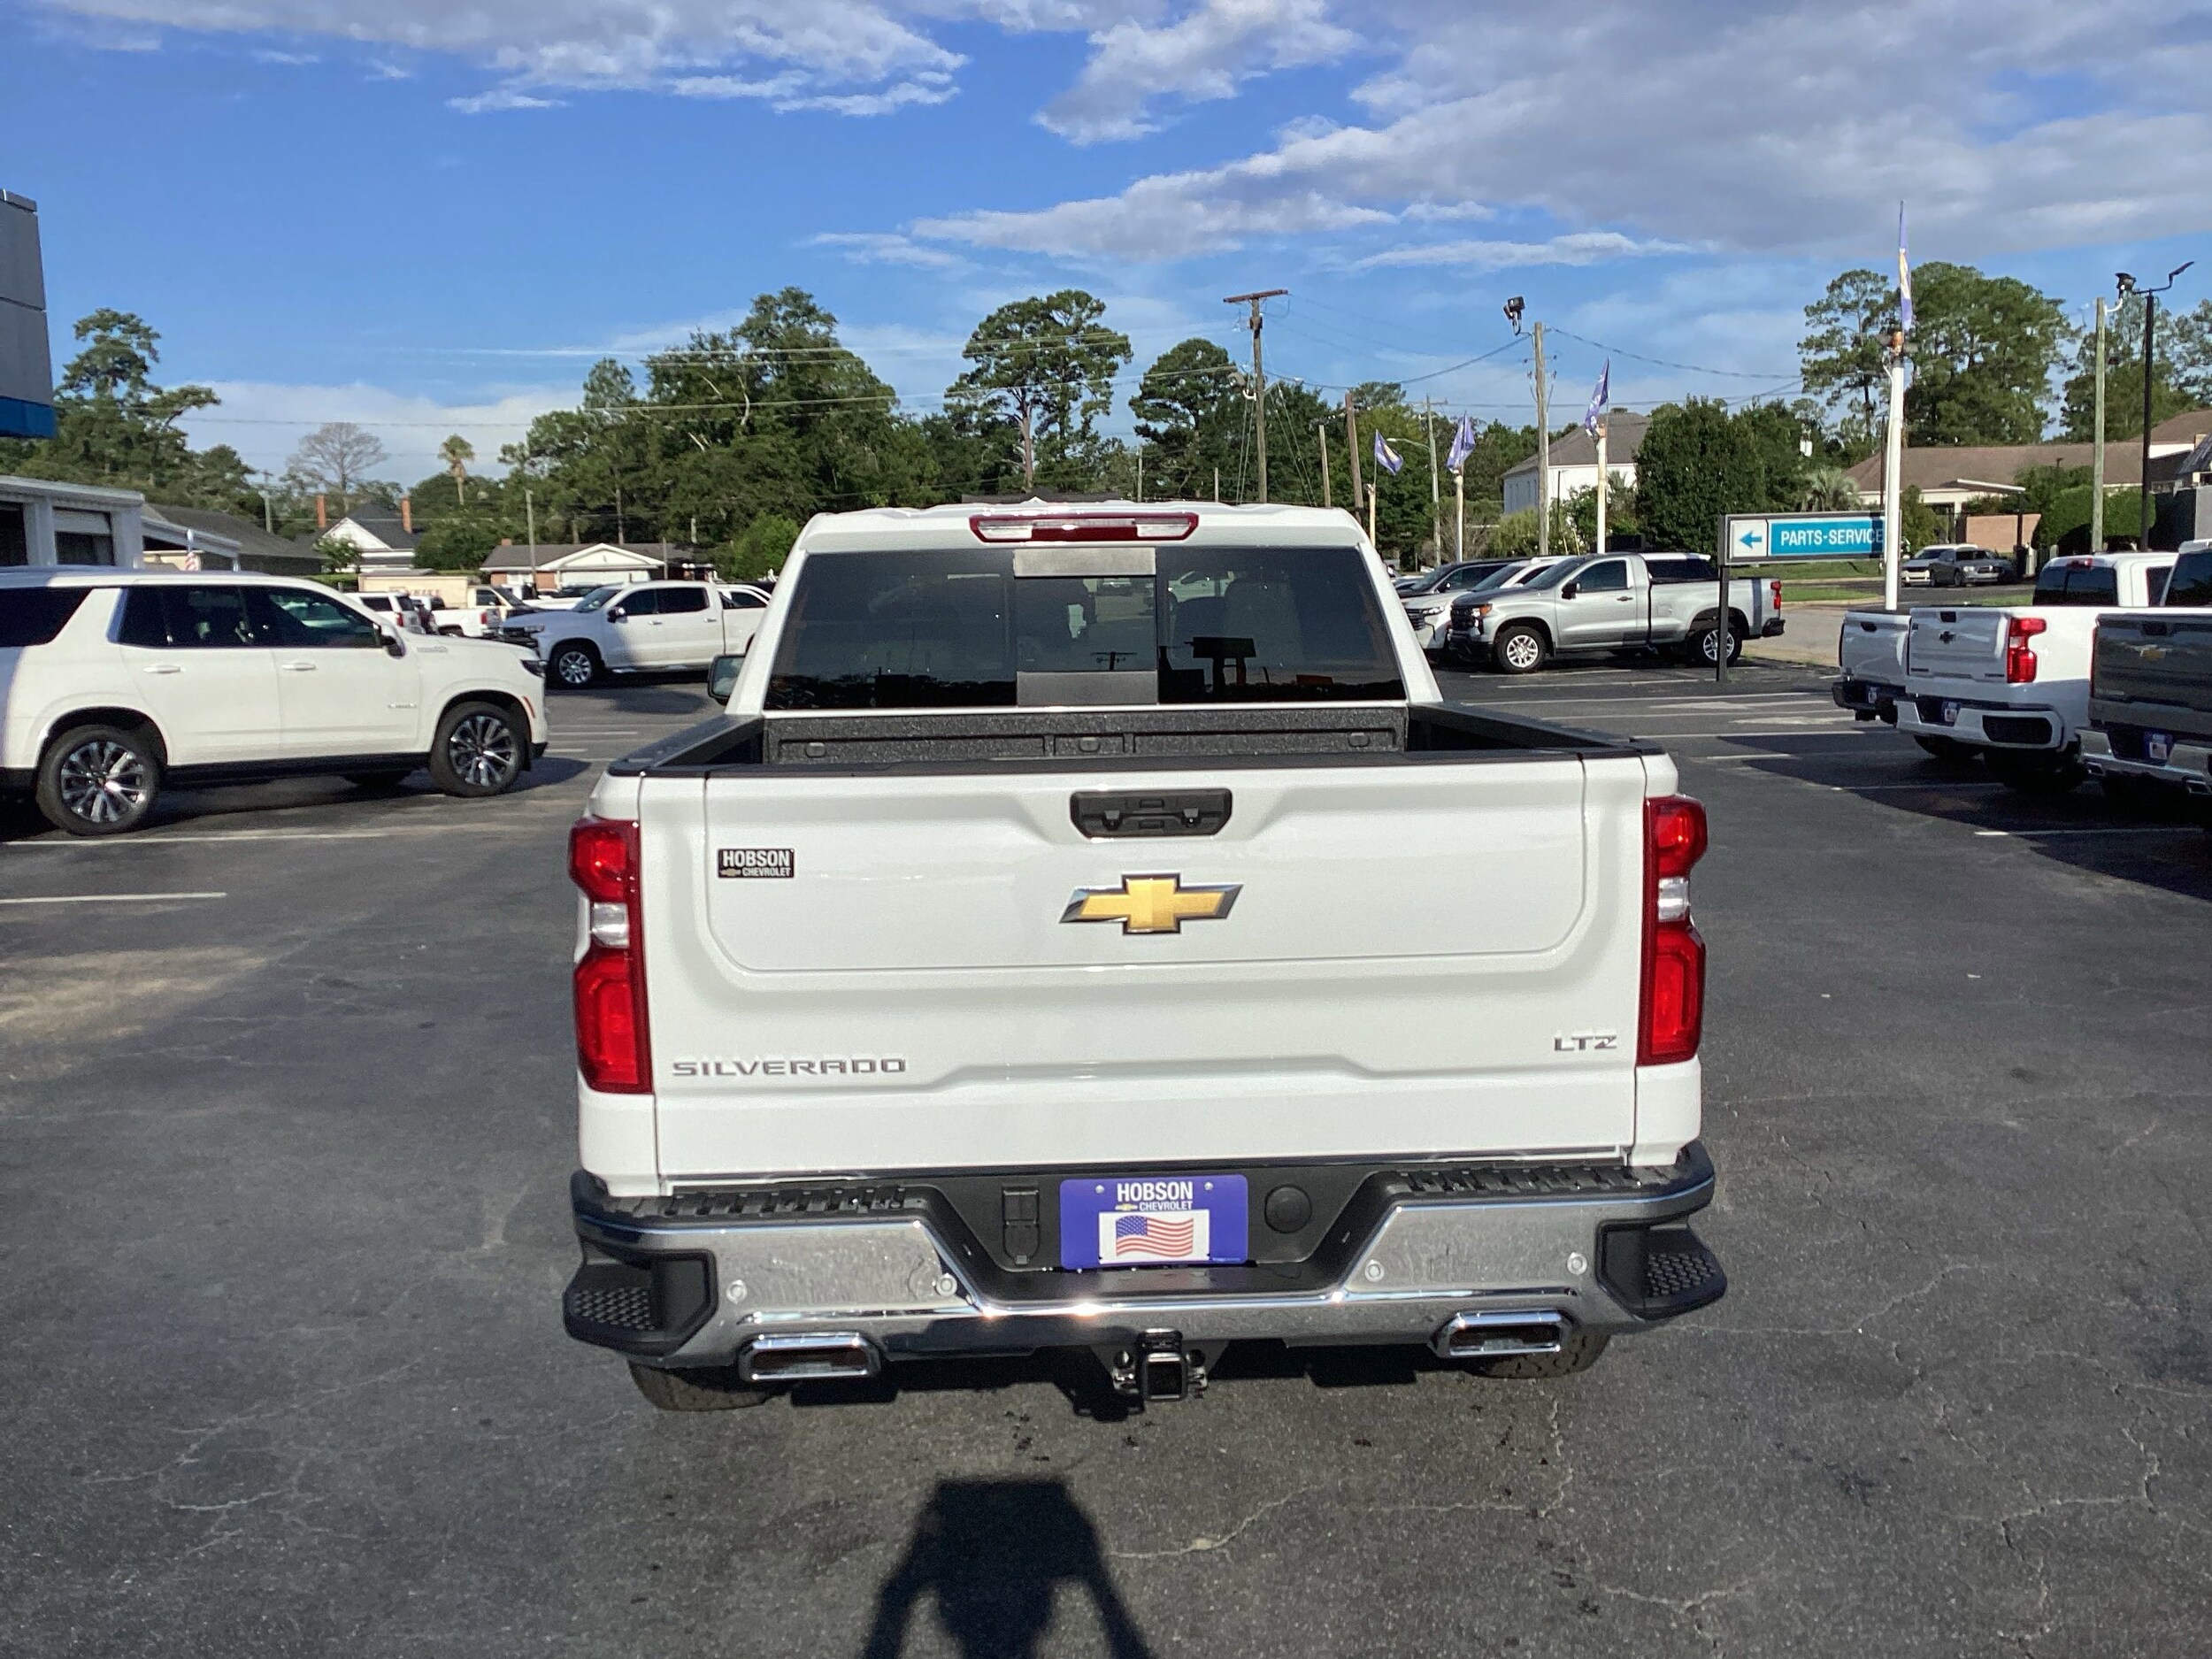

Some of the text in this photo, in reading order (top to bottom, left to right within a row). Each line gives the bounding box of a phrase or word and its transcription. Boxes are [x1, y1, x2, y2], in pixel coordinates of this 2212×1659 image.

[1780, 528, 1884, 547] PARTS-SERVICE
[722, 850, 790, 867] HOBSON
[741, 867, 792, 877] CHEVROLET
[1554, 1034, 1617, 1051] LTZ
[672, 1058, 907, 1076] SILVERADO
[1117, 1181, 1194, 1202] HOBSON
[1139, 1201, 1194, 1211] CHEVROLET
